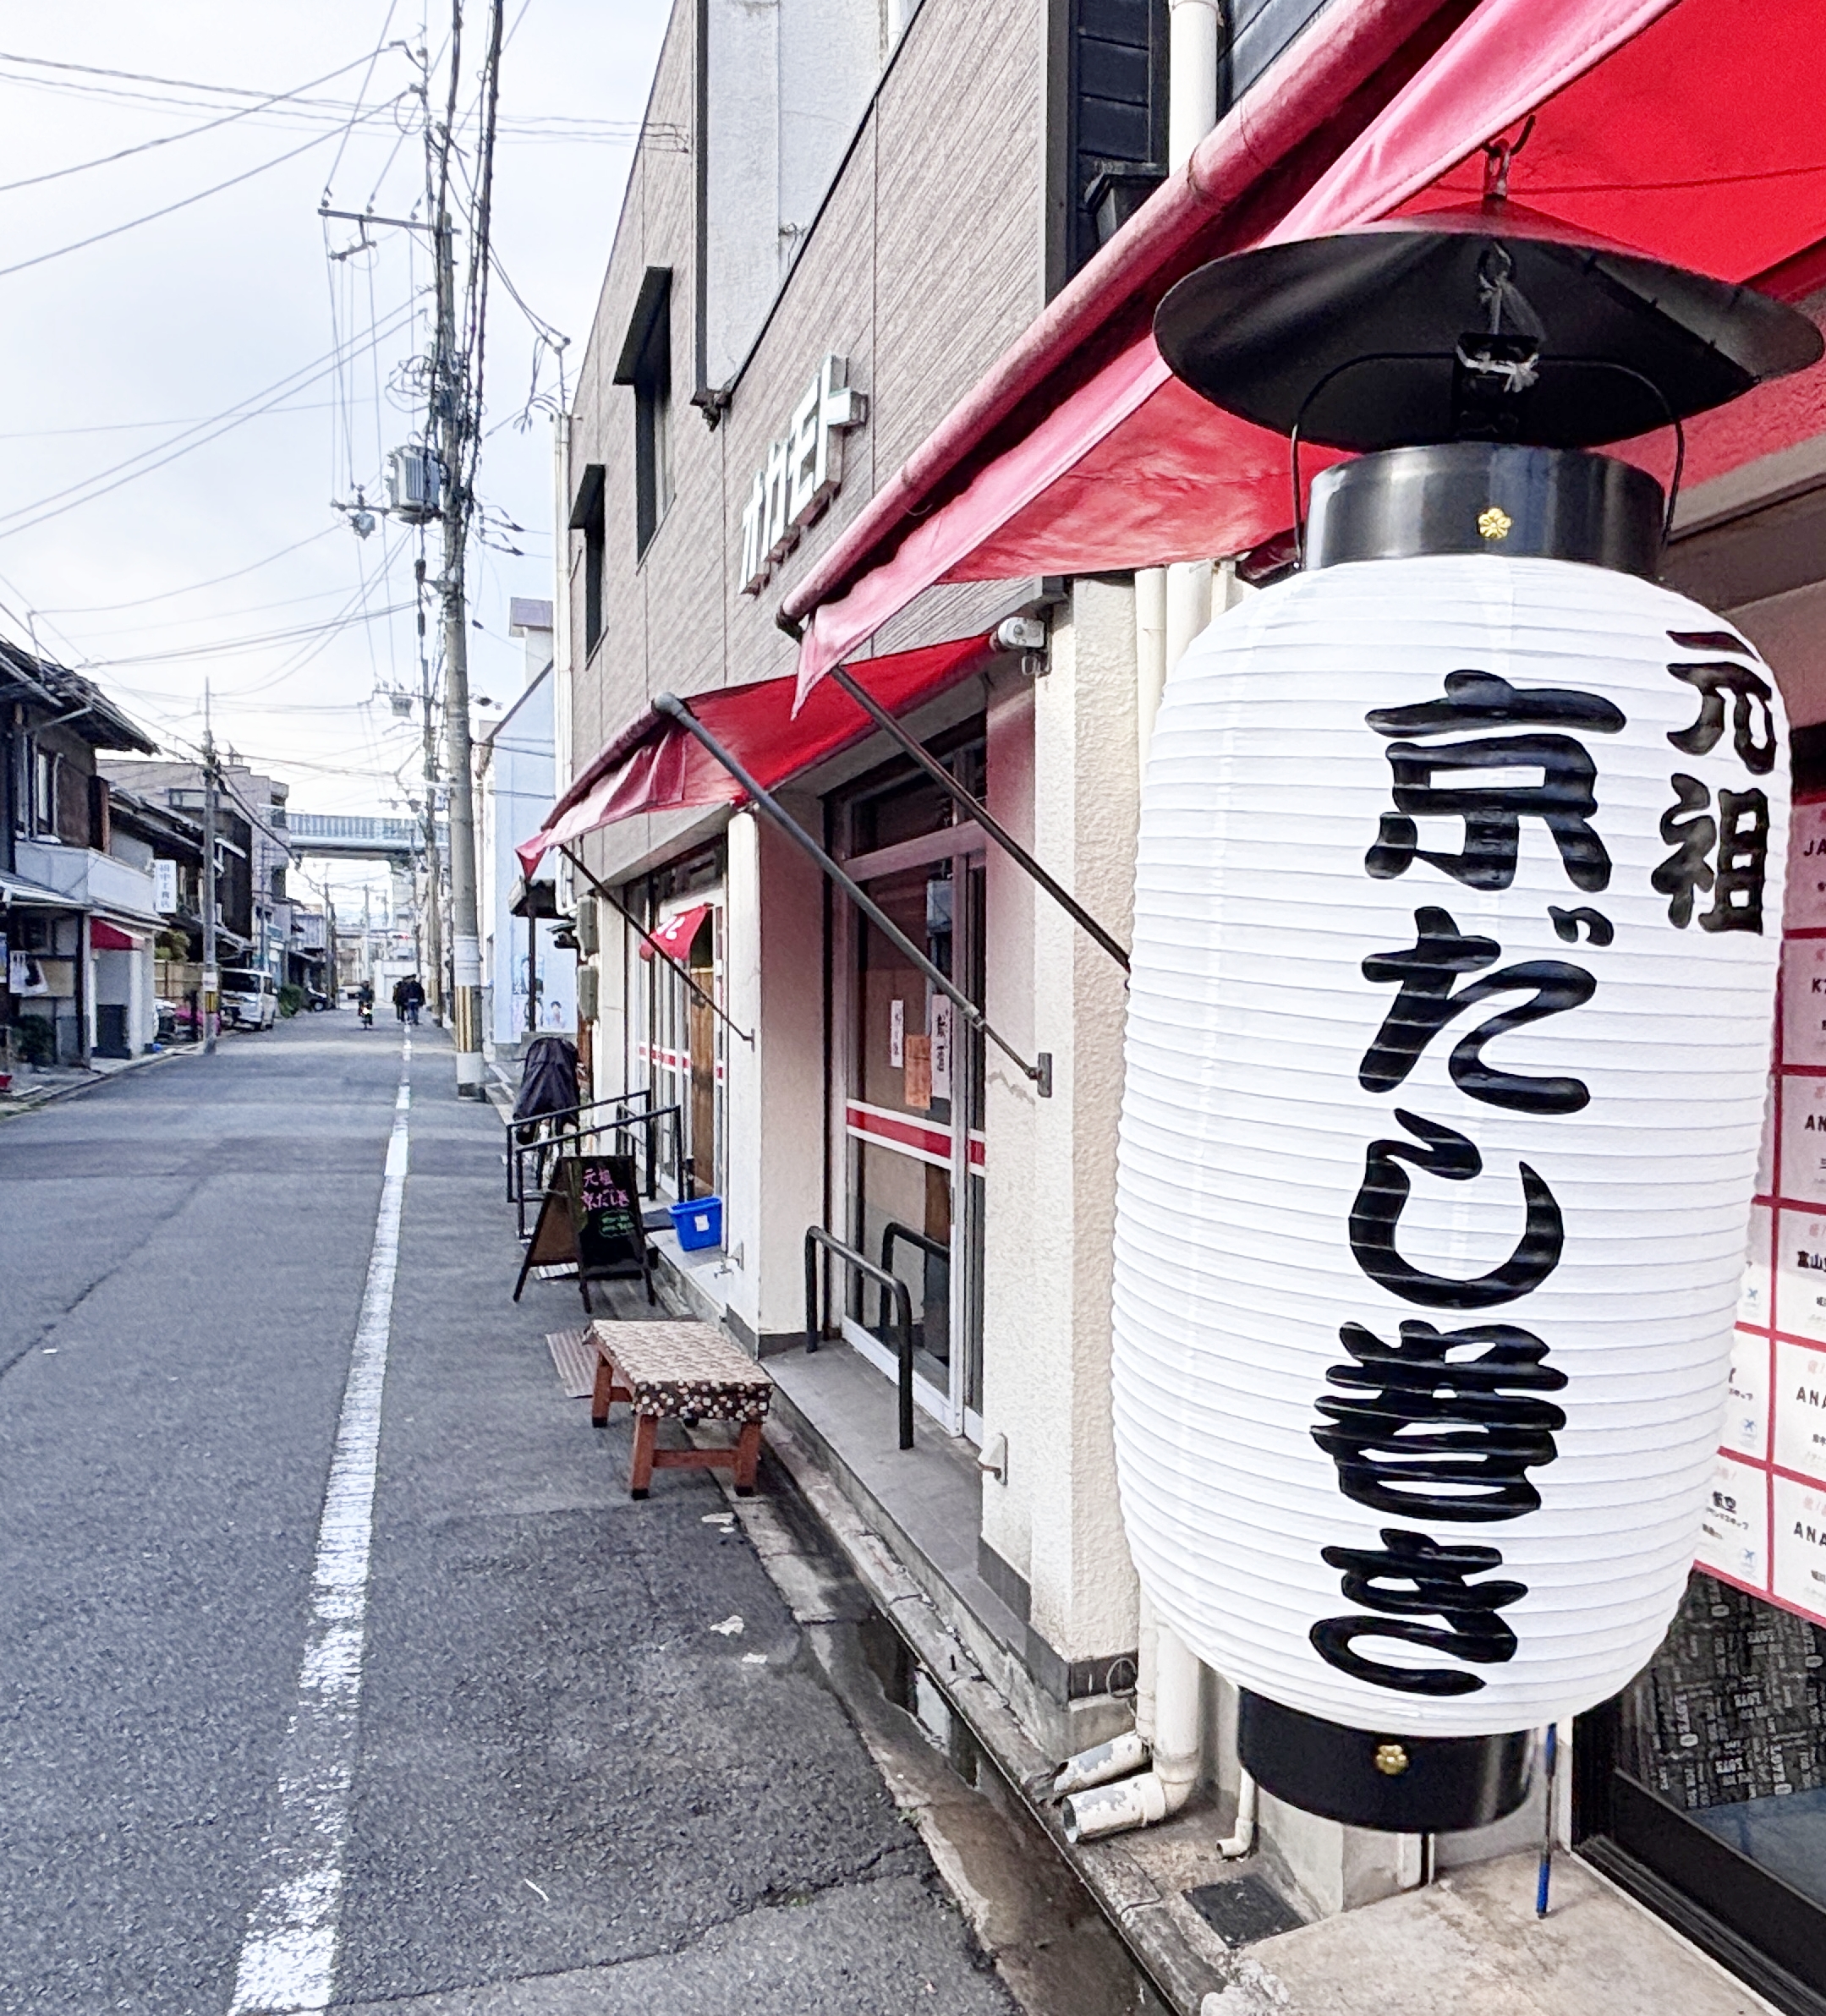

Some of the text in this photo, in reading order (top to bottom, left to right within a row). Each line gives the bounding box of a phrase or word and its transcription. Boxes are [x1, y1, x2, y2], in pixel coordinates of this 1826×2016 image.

[1652, 629, 1776, 934] 元祖
[1309, 669, 1628, 1696] 京だし巻き
